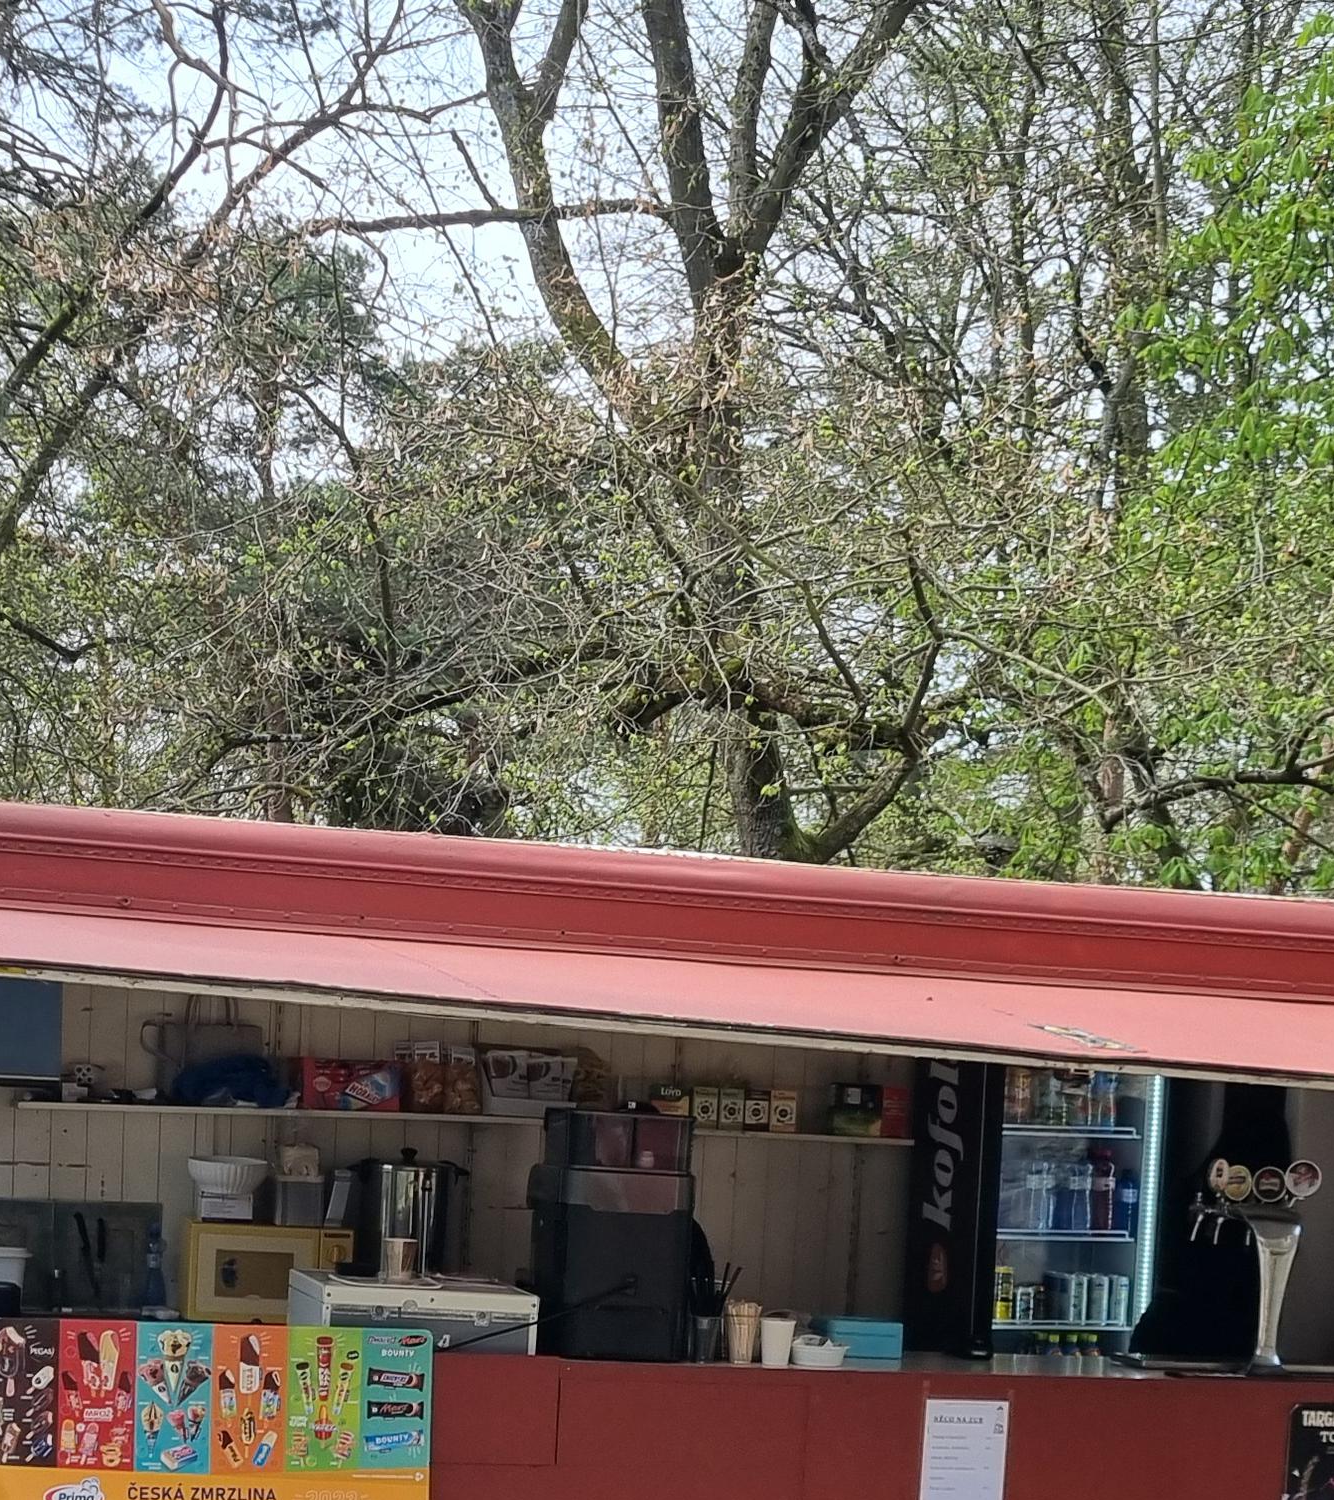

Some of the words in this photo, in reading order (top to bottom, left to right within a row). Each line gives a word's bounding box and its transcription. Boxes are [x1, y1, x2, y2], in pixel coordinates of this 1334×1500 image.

[922, 1058, 964, 1232] kofol
[376, 1434, 409, 1445] BOUNTY
[128, 1482, 185, 1500] ČESKÁ
